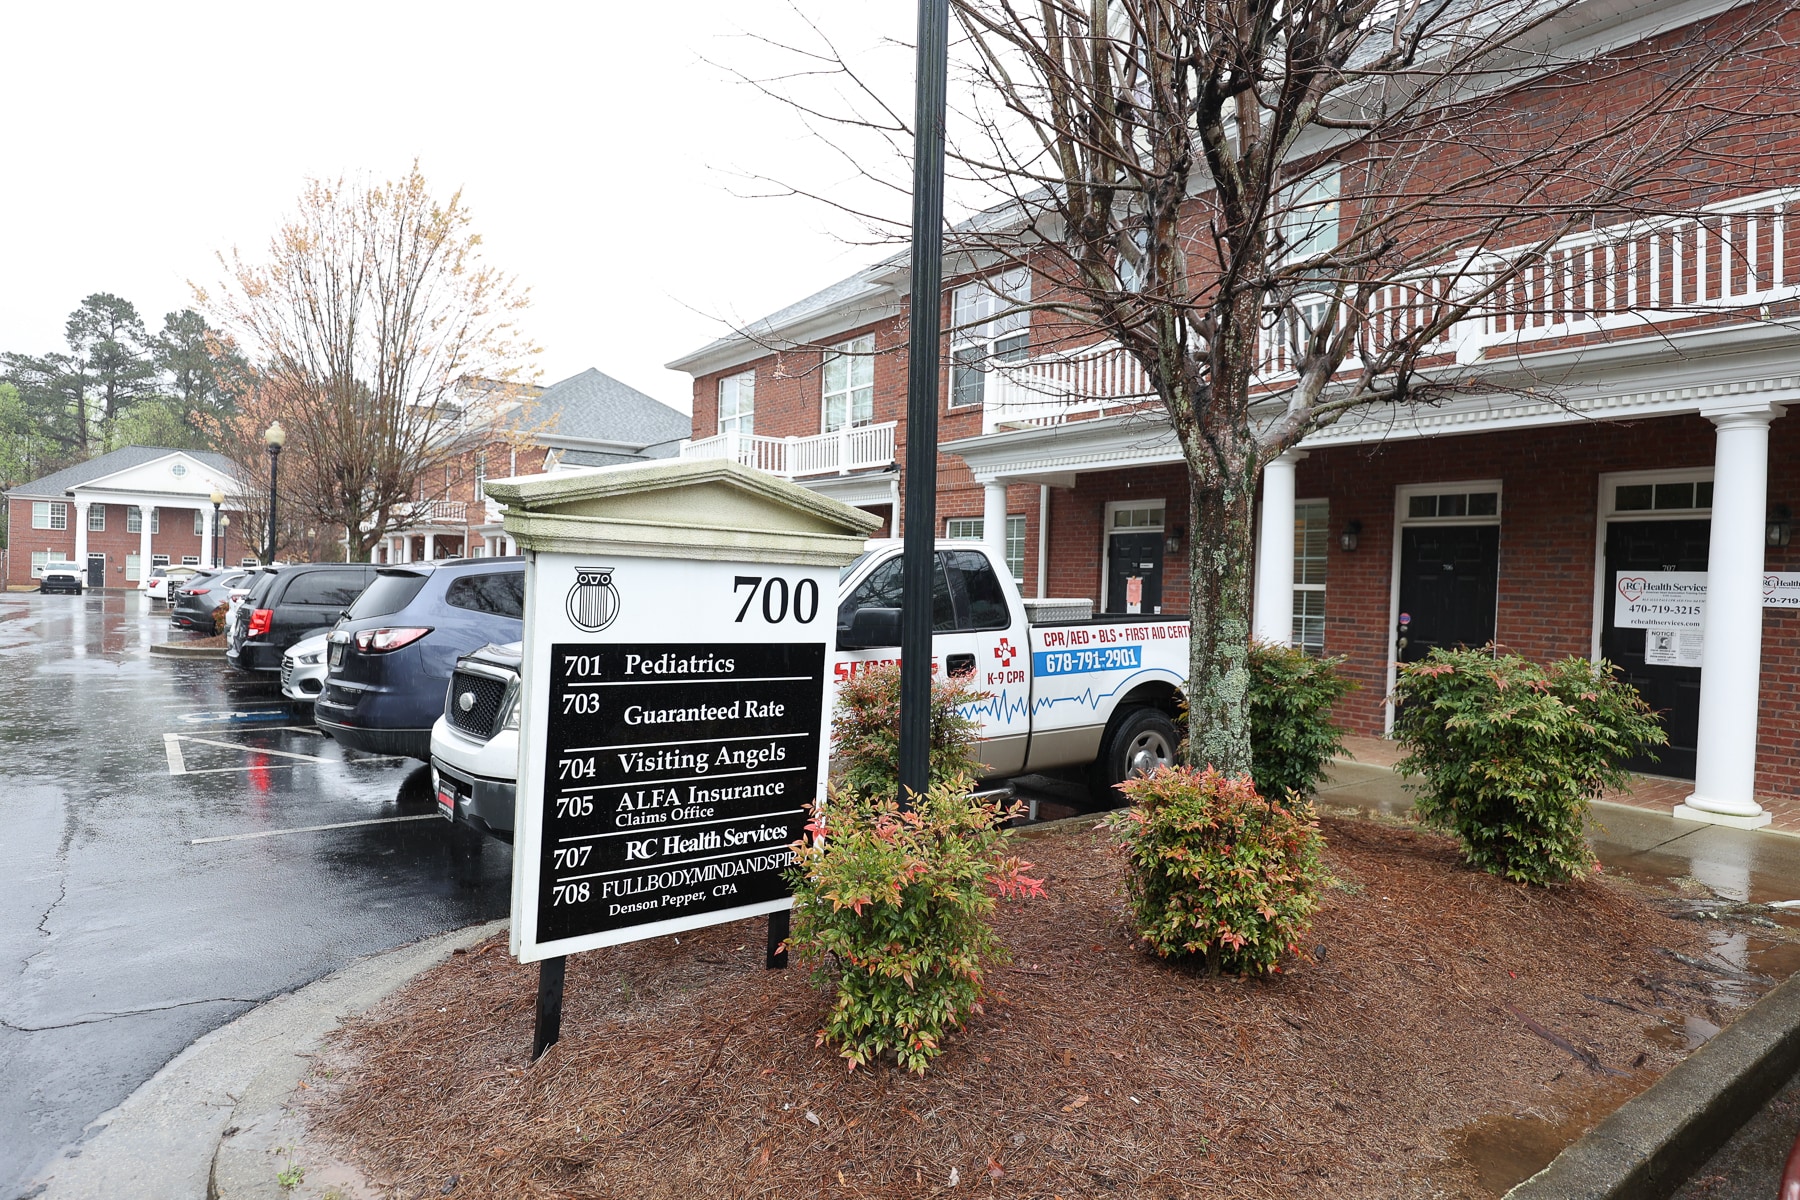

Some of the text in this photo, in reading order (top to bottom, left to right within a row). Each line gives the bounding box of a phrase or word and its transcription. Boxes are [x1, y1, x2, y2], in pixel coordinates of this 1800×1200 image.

[1626, 582, 1641, 590] RC
[1643, 582, 1671, 591] Health
[733, 575, 819, 624] 700
[1629, 604, 1701, 615] 470-719-3215
[1631, 619, 1700, 627] rchealthservices.com
[1044, 630, 1089, 648] CPR/AED
[1099, 629, 1117, 643] BLS
[1125, 627, 1149, 641] FIRST
[1151, 626, 1166, 640] AID
[564, 653, 735, 677] 701 Pediatrics
[1046, 648, 1138, 673] 678-791-2901
[988, 670, 1024, 685] K-9 CPR
[562, 693, 600, 715] 703
[624, 700, 785, 725] Guaranteed Rate
[558, 742, 786, 780] 704 Visiting Angels
[556, 782, 785, 818] 705 ALFA Insurance
[615, 806, 714, 827] Claims Office
[553, 824, 788, 870] 707 RC Health Services
[552, 851, 802, 907] 708 FULLBODY,MINDANDSPIR
[609, 883, 738, 916] Denson Pepper, CPA
